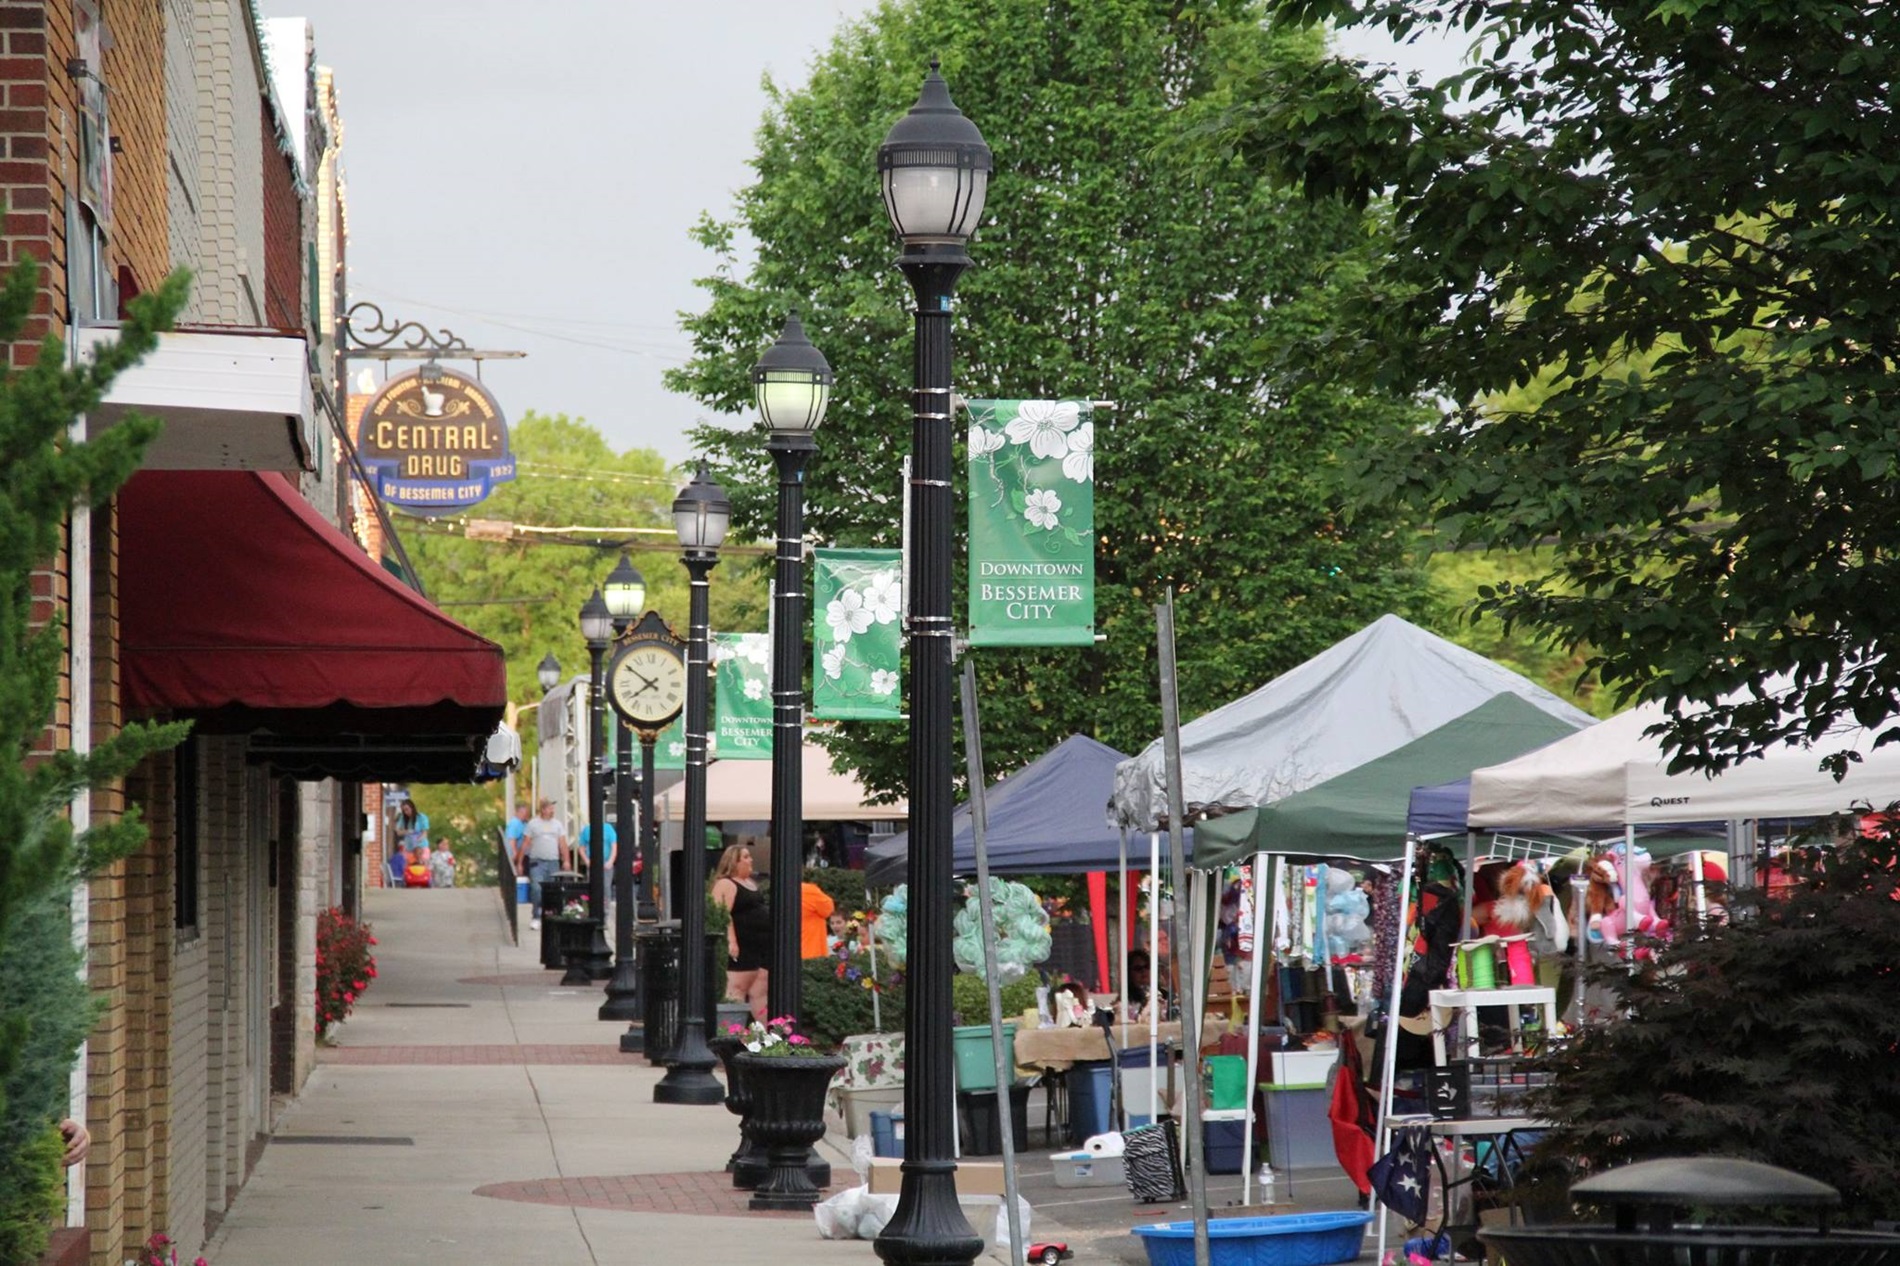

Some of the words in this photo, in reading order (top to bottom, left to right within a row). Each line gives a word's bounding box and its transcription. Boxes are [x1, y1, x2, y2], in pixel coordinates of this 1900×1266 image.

[377, 421, 492, 450] CENTRAL
[408, 455, 461, 476] DRUG
[384, 483, 398, 498] OF
[399, 486, 455, 500] BESSEMER
[458, 484, 482, 499] CITY
[981, 562, 1083, 576] DOWNTOWN
[981, 583, 1083, 601] BESSEMER
[1006, 602, 1057, 620] CITY
[623, 632, 659, 647] BESSEMER
[660, 633, 679, 647] CITY
[721, 716, 774, 724] DOWNTOWN
[721, 726, 774, 737] BESSEMER
[734, 736, 761, 746] CITY
[1651, 797, 1690, 807] QUEST
